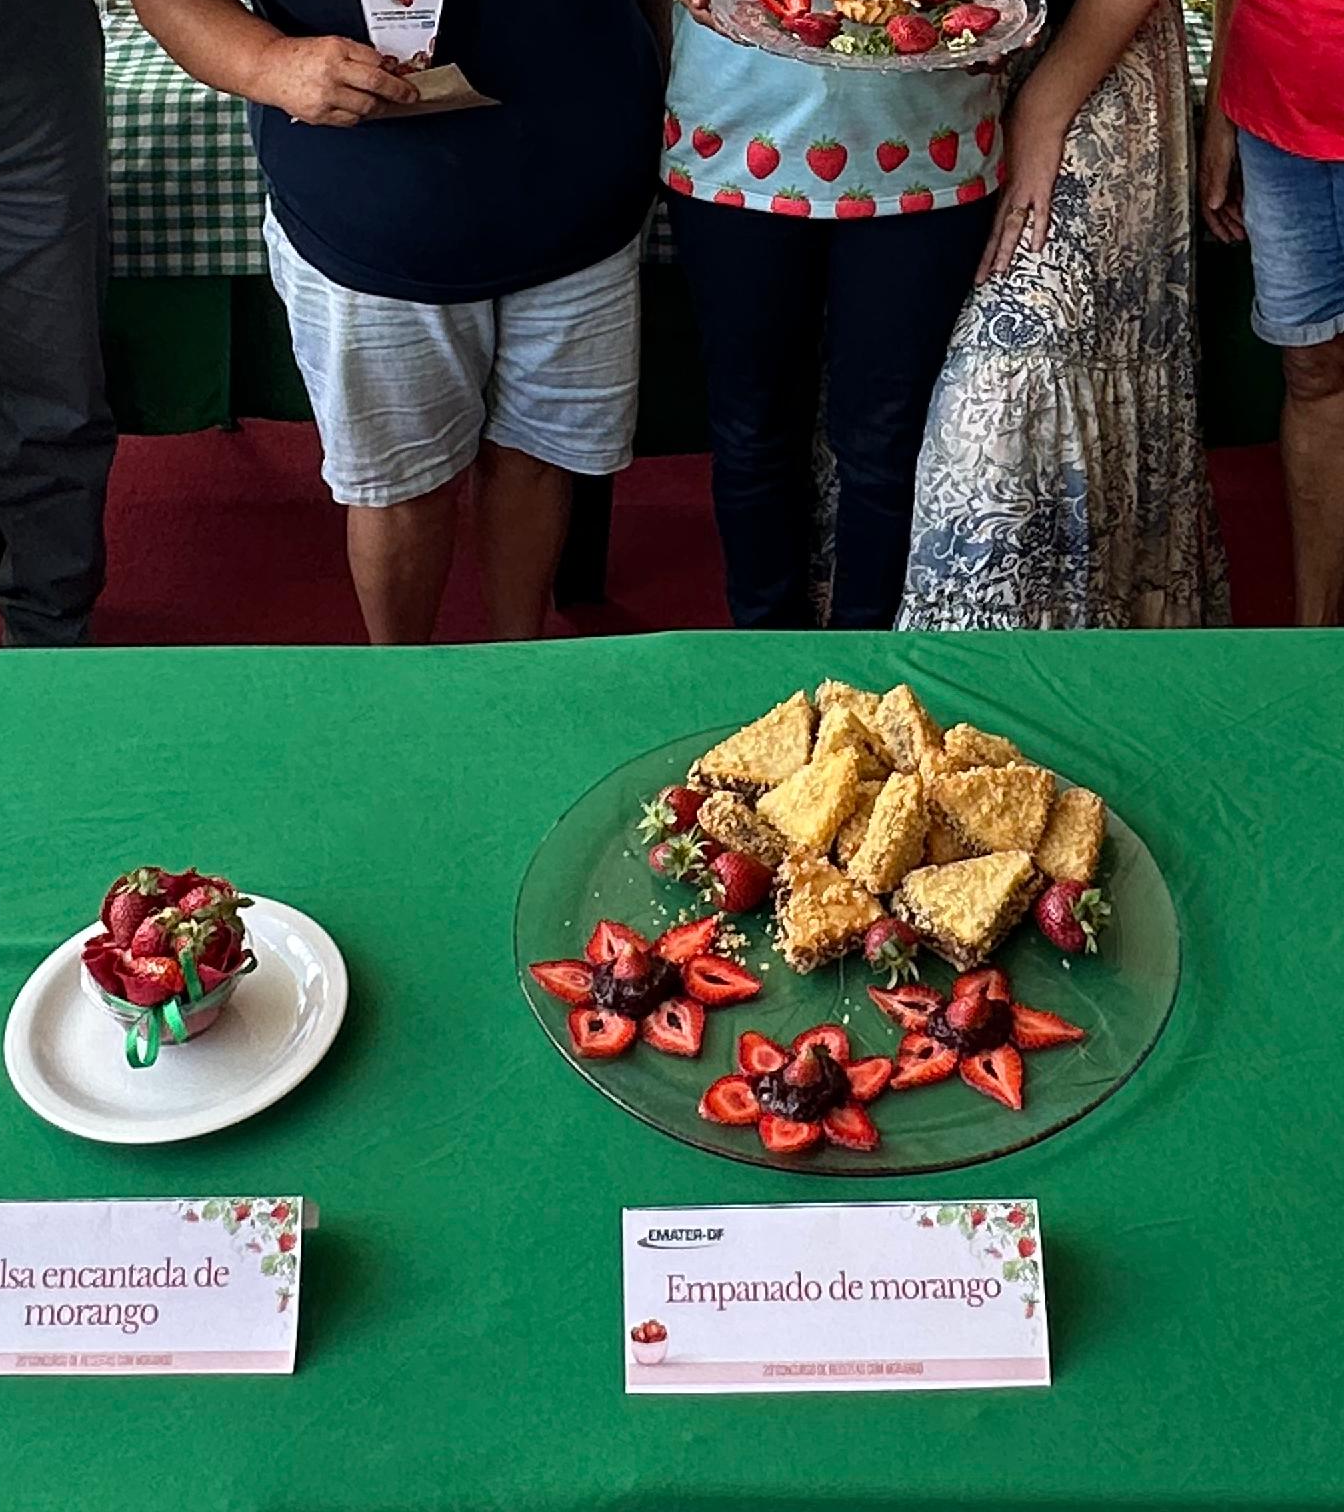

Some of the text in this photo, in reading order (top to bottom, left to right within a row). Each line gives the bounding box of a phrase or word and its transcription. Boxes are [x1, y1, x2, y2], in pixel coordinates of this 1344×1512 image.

[42, 1256, 188, 1290] encantada
[194, 1255, 230, 1288] de
[666, 1270, 1003, 1312] Empanado de morango
[24, 1301, 159, 1335] morango
